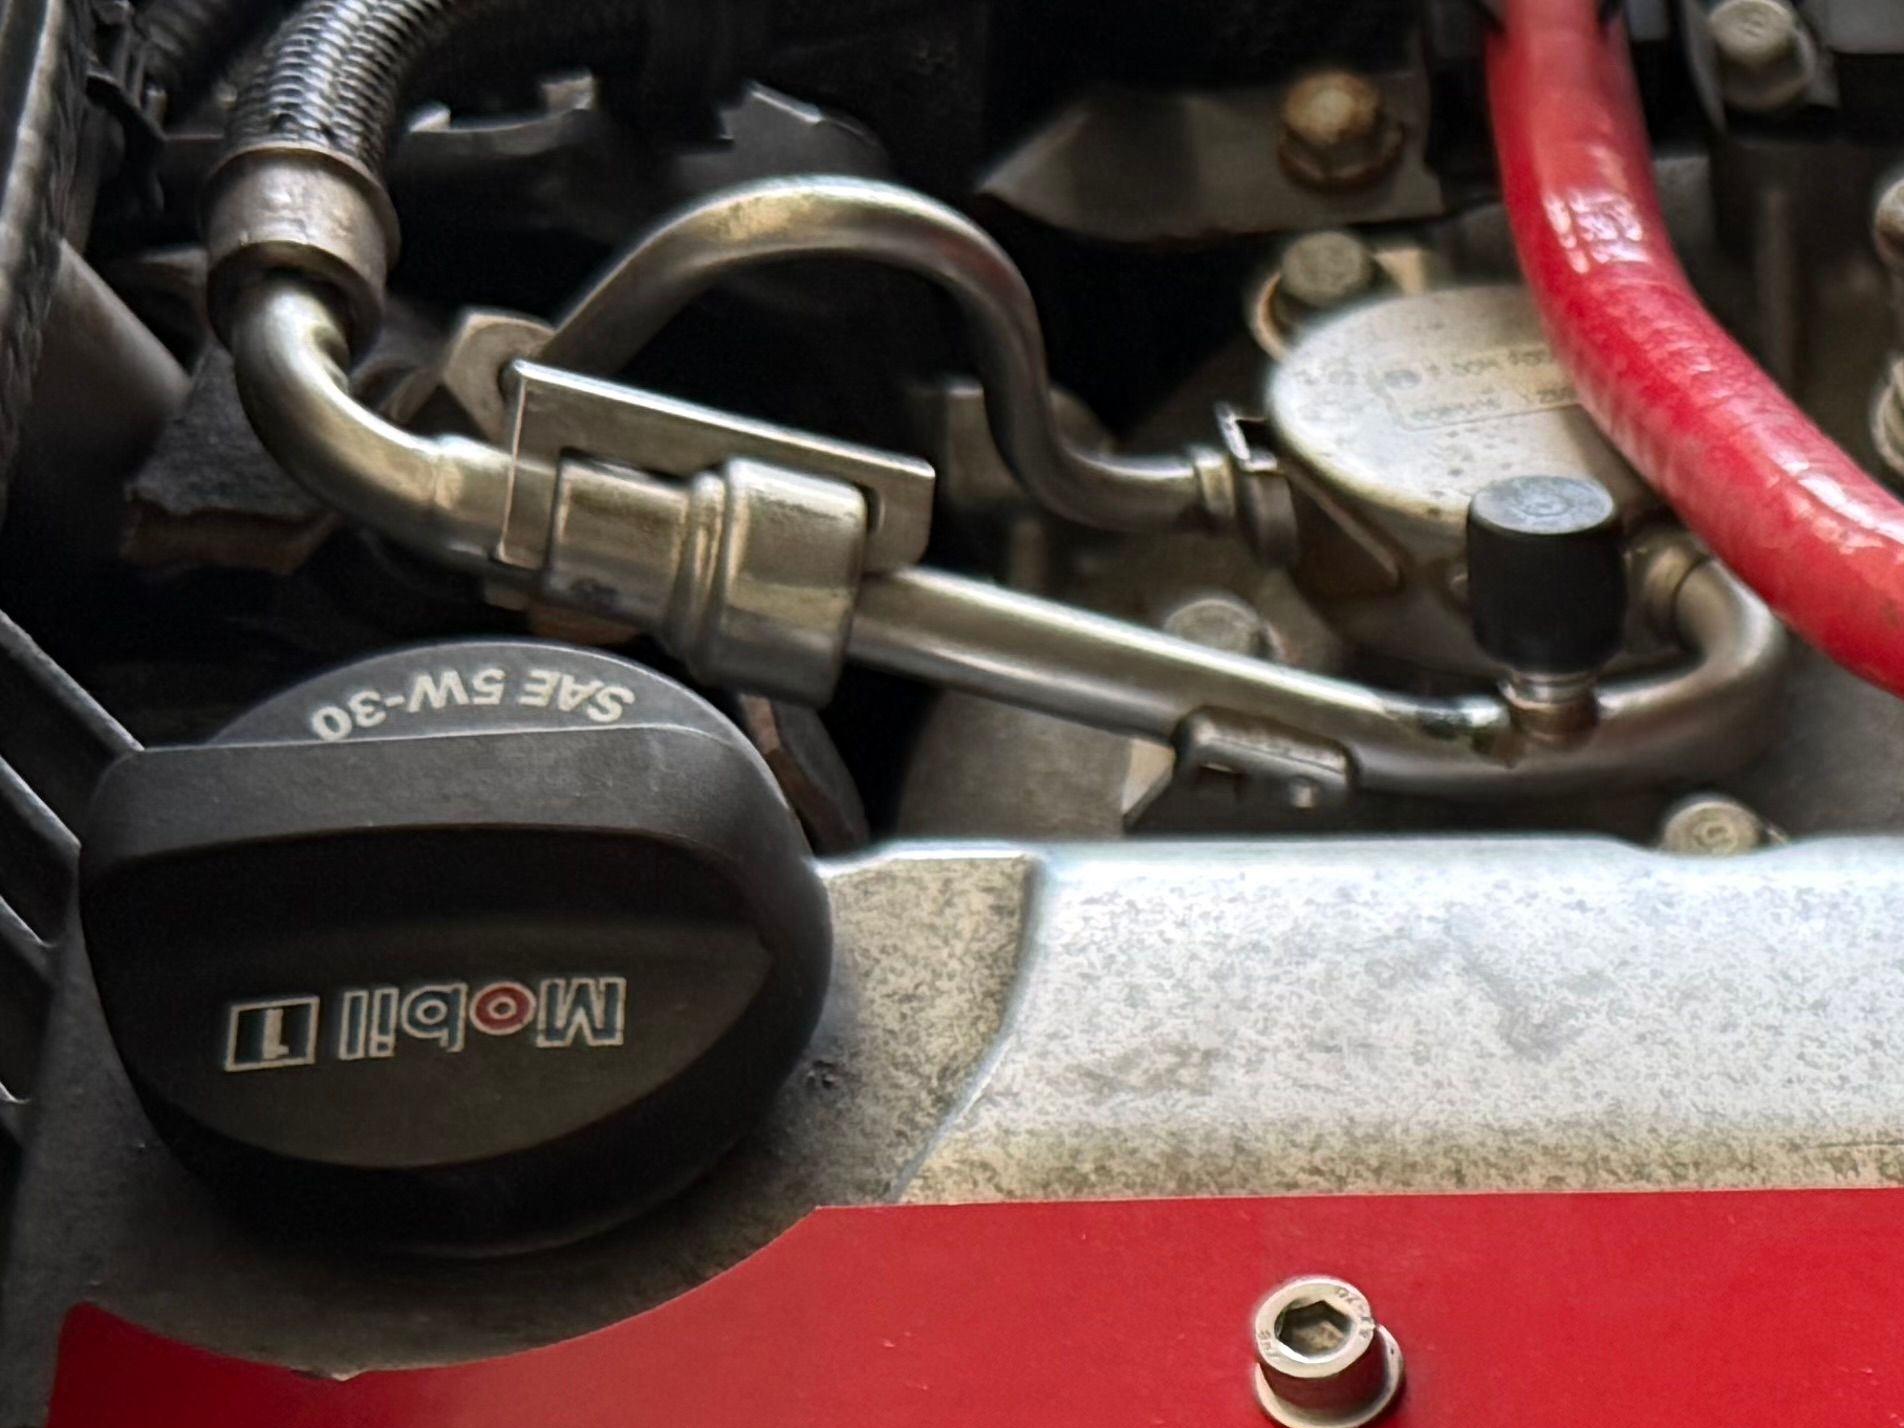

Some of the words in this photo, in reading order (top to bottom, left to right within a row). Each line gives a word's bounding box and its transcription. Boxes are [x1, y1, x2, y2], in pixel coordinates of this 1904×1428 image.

[311, 668, 506, 742] 5W-30
[522, 668, 635, 724] SAE
[338, 976, 628, 1062] Mobil
